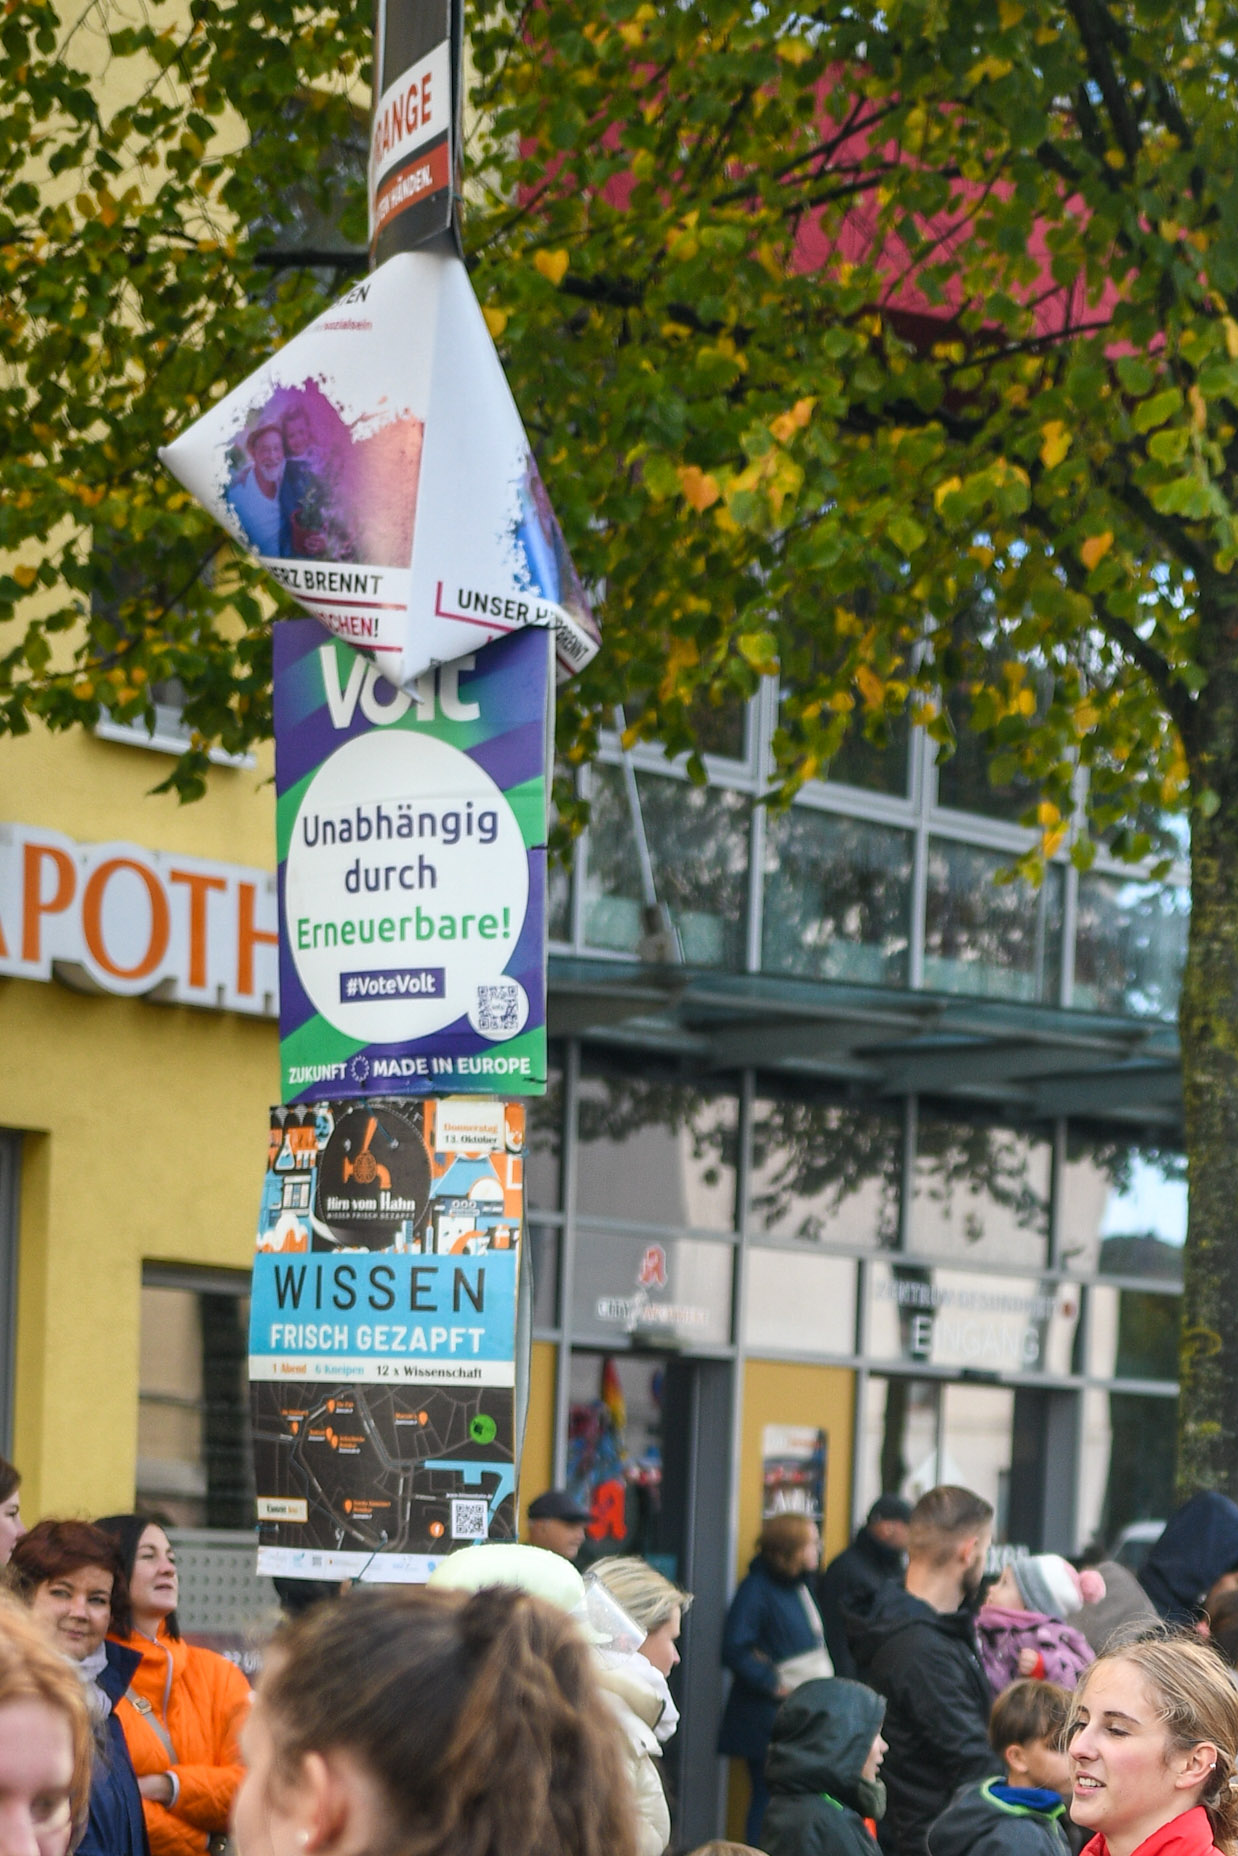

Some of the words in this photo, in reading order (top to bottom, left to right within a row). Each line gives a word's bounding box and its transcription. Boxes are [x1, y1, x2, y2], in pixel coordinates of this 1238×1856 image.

[304, 570, 383, 595] BRENNT
[458, 588, 529, 623] UNSER
[303, 801, 498, 847] Unabhängig
[345, 855, 437, 893] durch
[0, 843, 279, 996] POTH
[297, 906, 511, 950] Erneuerbare!
[345, 972, 436, 997] #VoteVolt
[289, 1063, 347, 1084] ZUKUNFT
[373, 1058, 429, 1077] MADE
[433, 1057, 452, 1075] IN
[458, 1057, 531, 1075] EUROPE
[352, 1199, 377, 1211] vom
[380, 1191, 415, 1212] Hahn
[274, 1265, 485, 1313] WISSEN
[270, 1324, 348, 1351] FRISCH
[357, 1326, 485, 1354] GEZAPFT
[324, 1364, 364, 1377] Kneipen
[377, 1365, 390, 1376] 12
[404, 1364, 483, 1379] Wissenschaft
